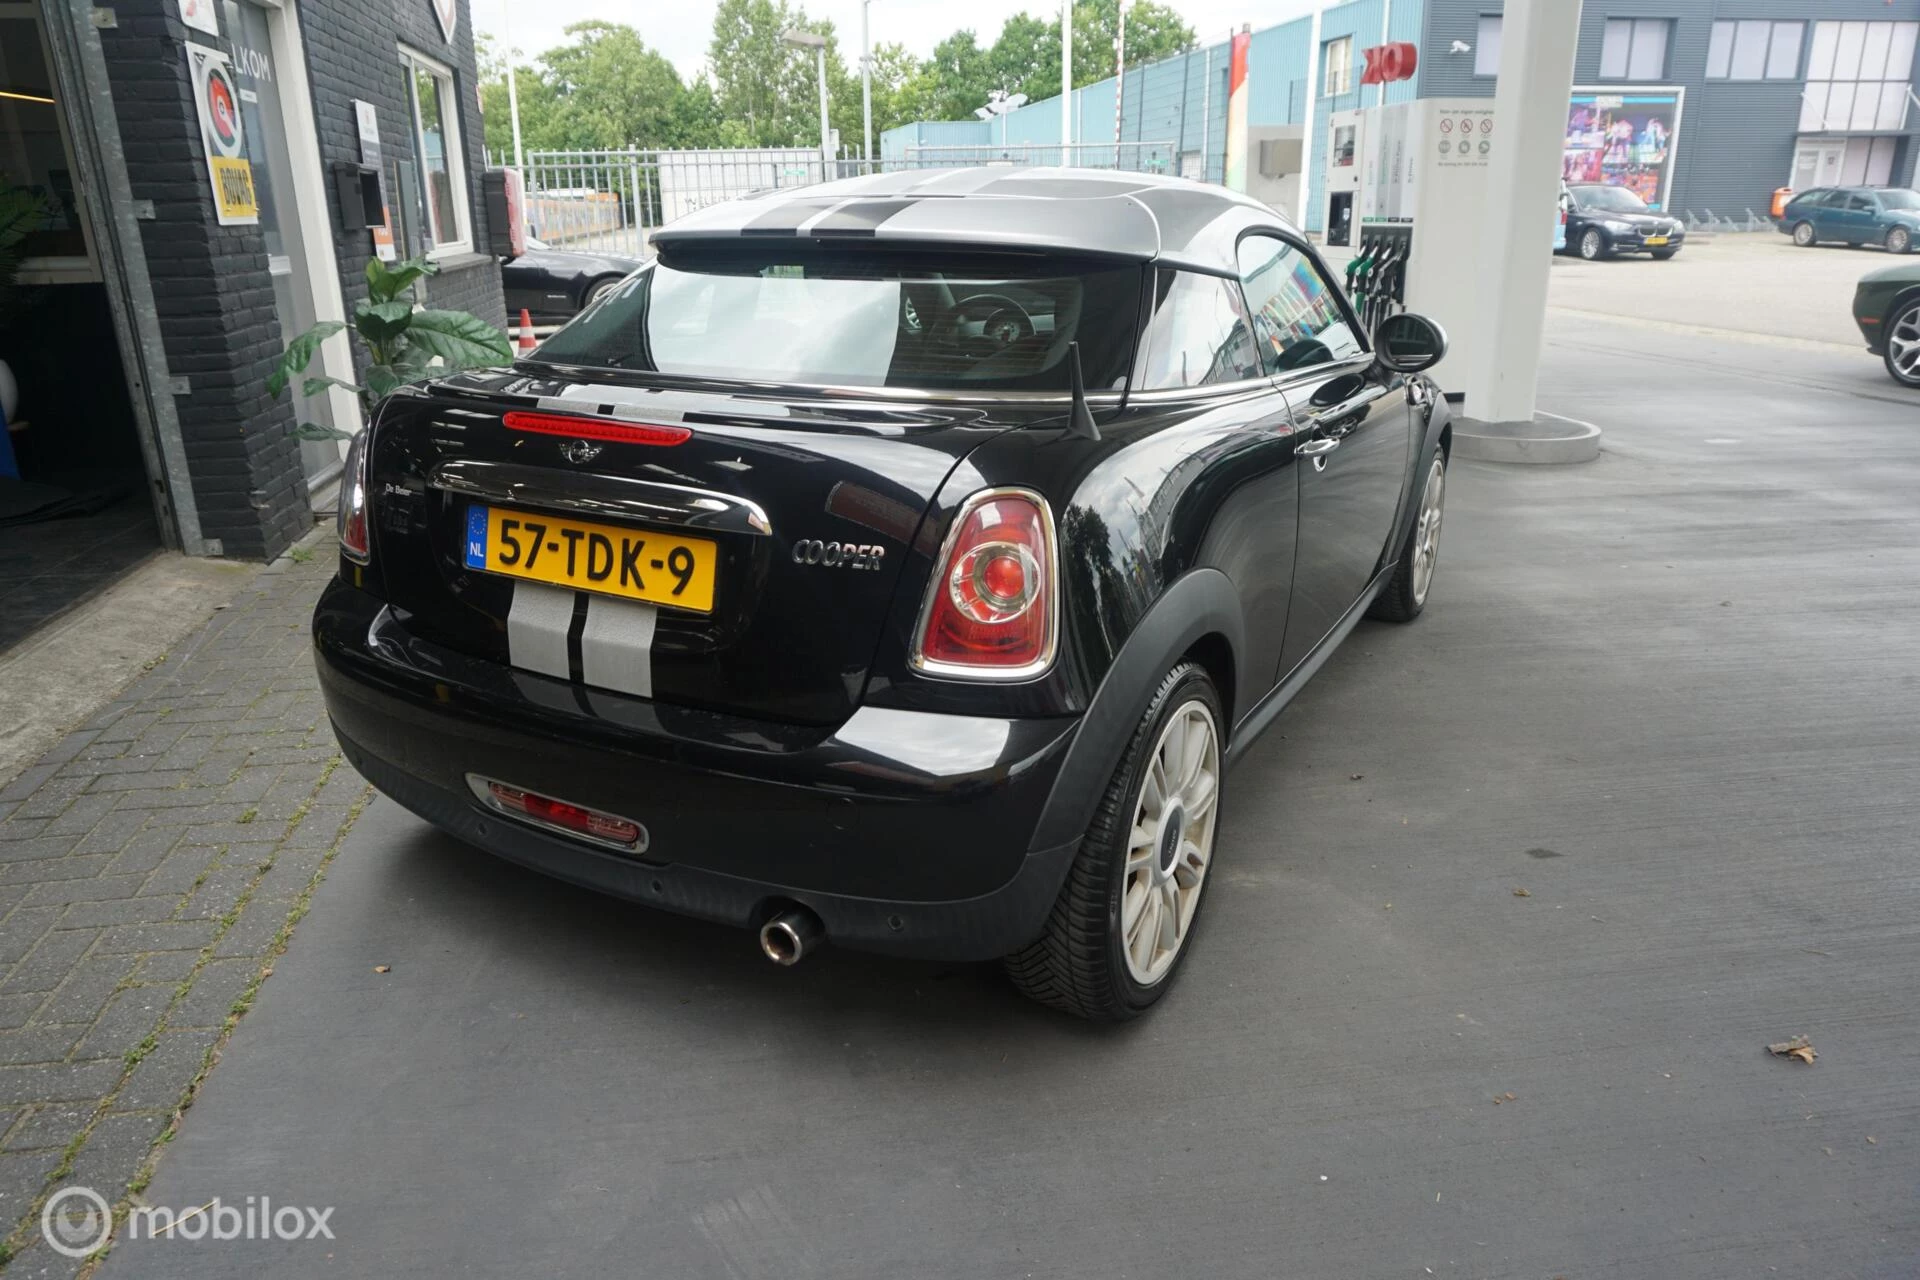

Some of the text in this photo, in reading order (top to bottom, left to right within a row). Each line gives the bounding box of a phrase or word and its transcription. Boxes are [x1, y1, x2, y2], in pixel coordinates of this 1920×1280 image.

[231, 43, 271, 82] LKOM
[470, 541, 484, 558] NL
[499, 518, 695, 596] 57-TDK-9
[792, 539, 885, 570] COOPER
